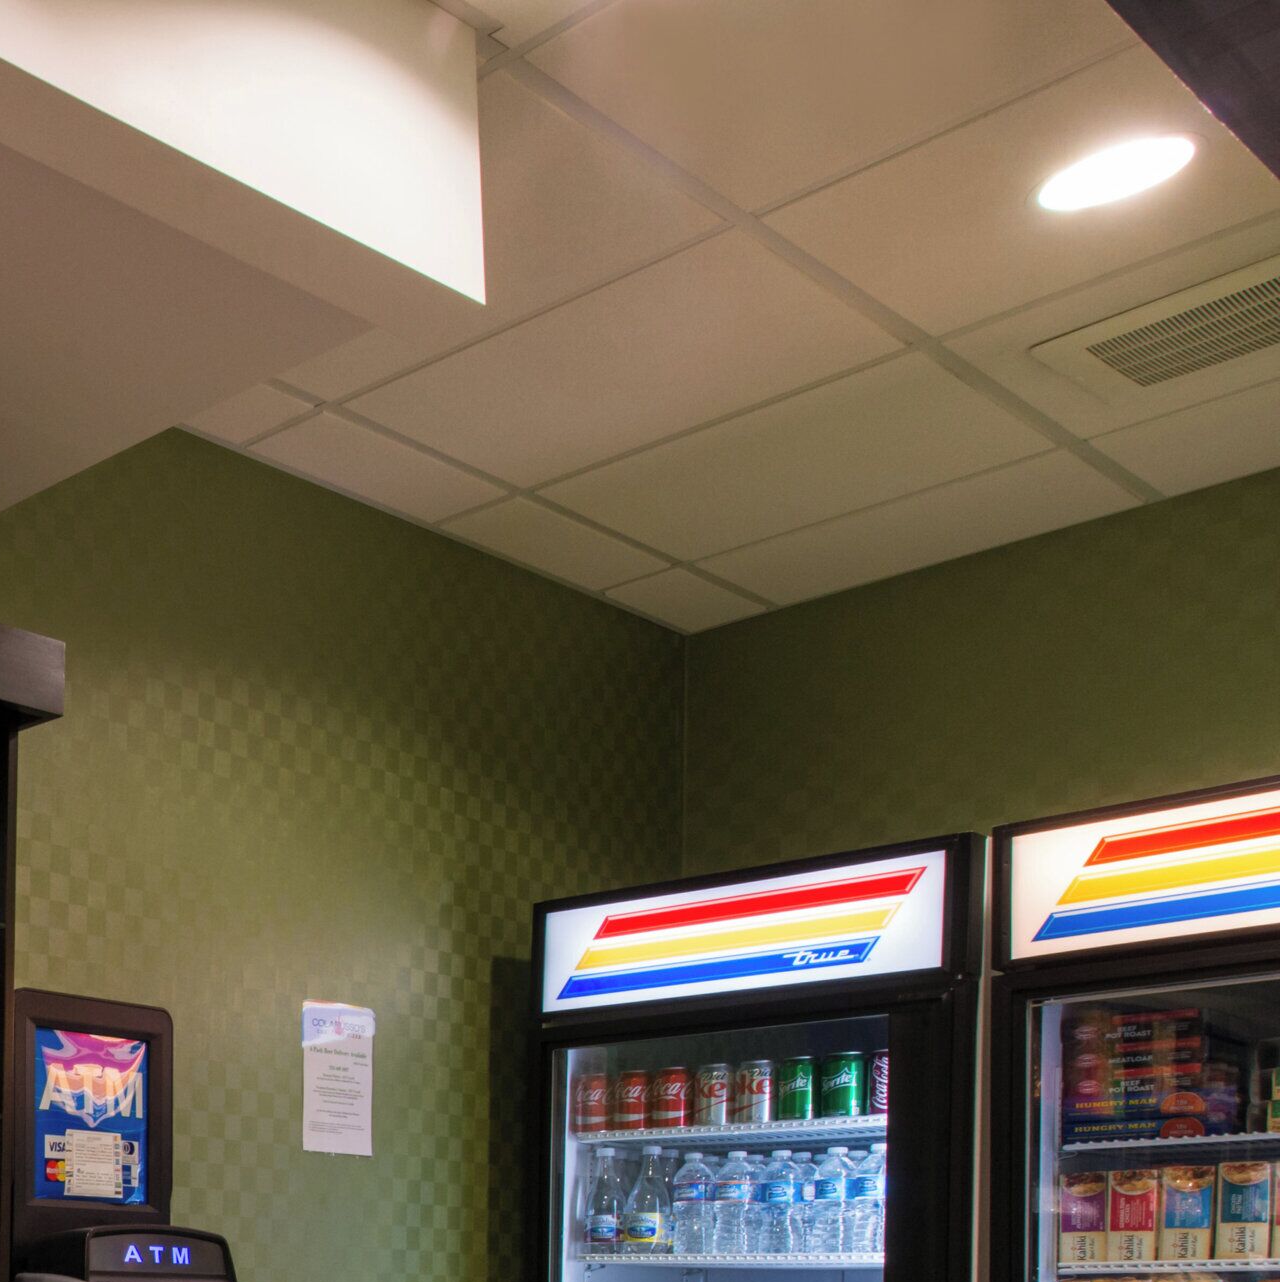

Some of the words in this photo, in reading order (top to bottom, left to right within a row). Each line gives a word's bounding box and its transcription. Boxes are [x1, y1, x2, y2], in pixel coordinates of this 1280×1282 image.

[1117, 1023, 1138, 1033] BEEF
[39, 1062, 144, 1119] ATM
[1075, 1098, 1124, 1109] HUNGRY
